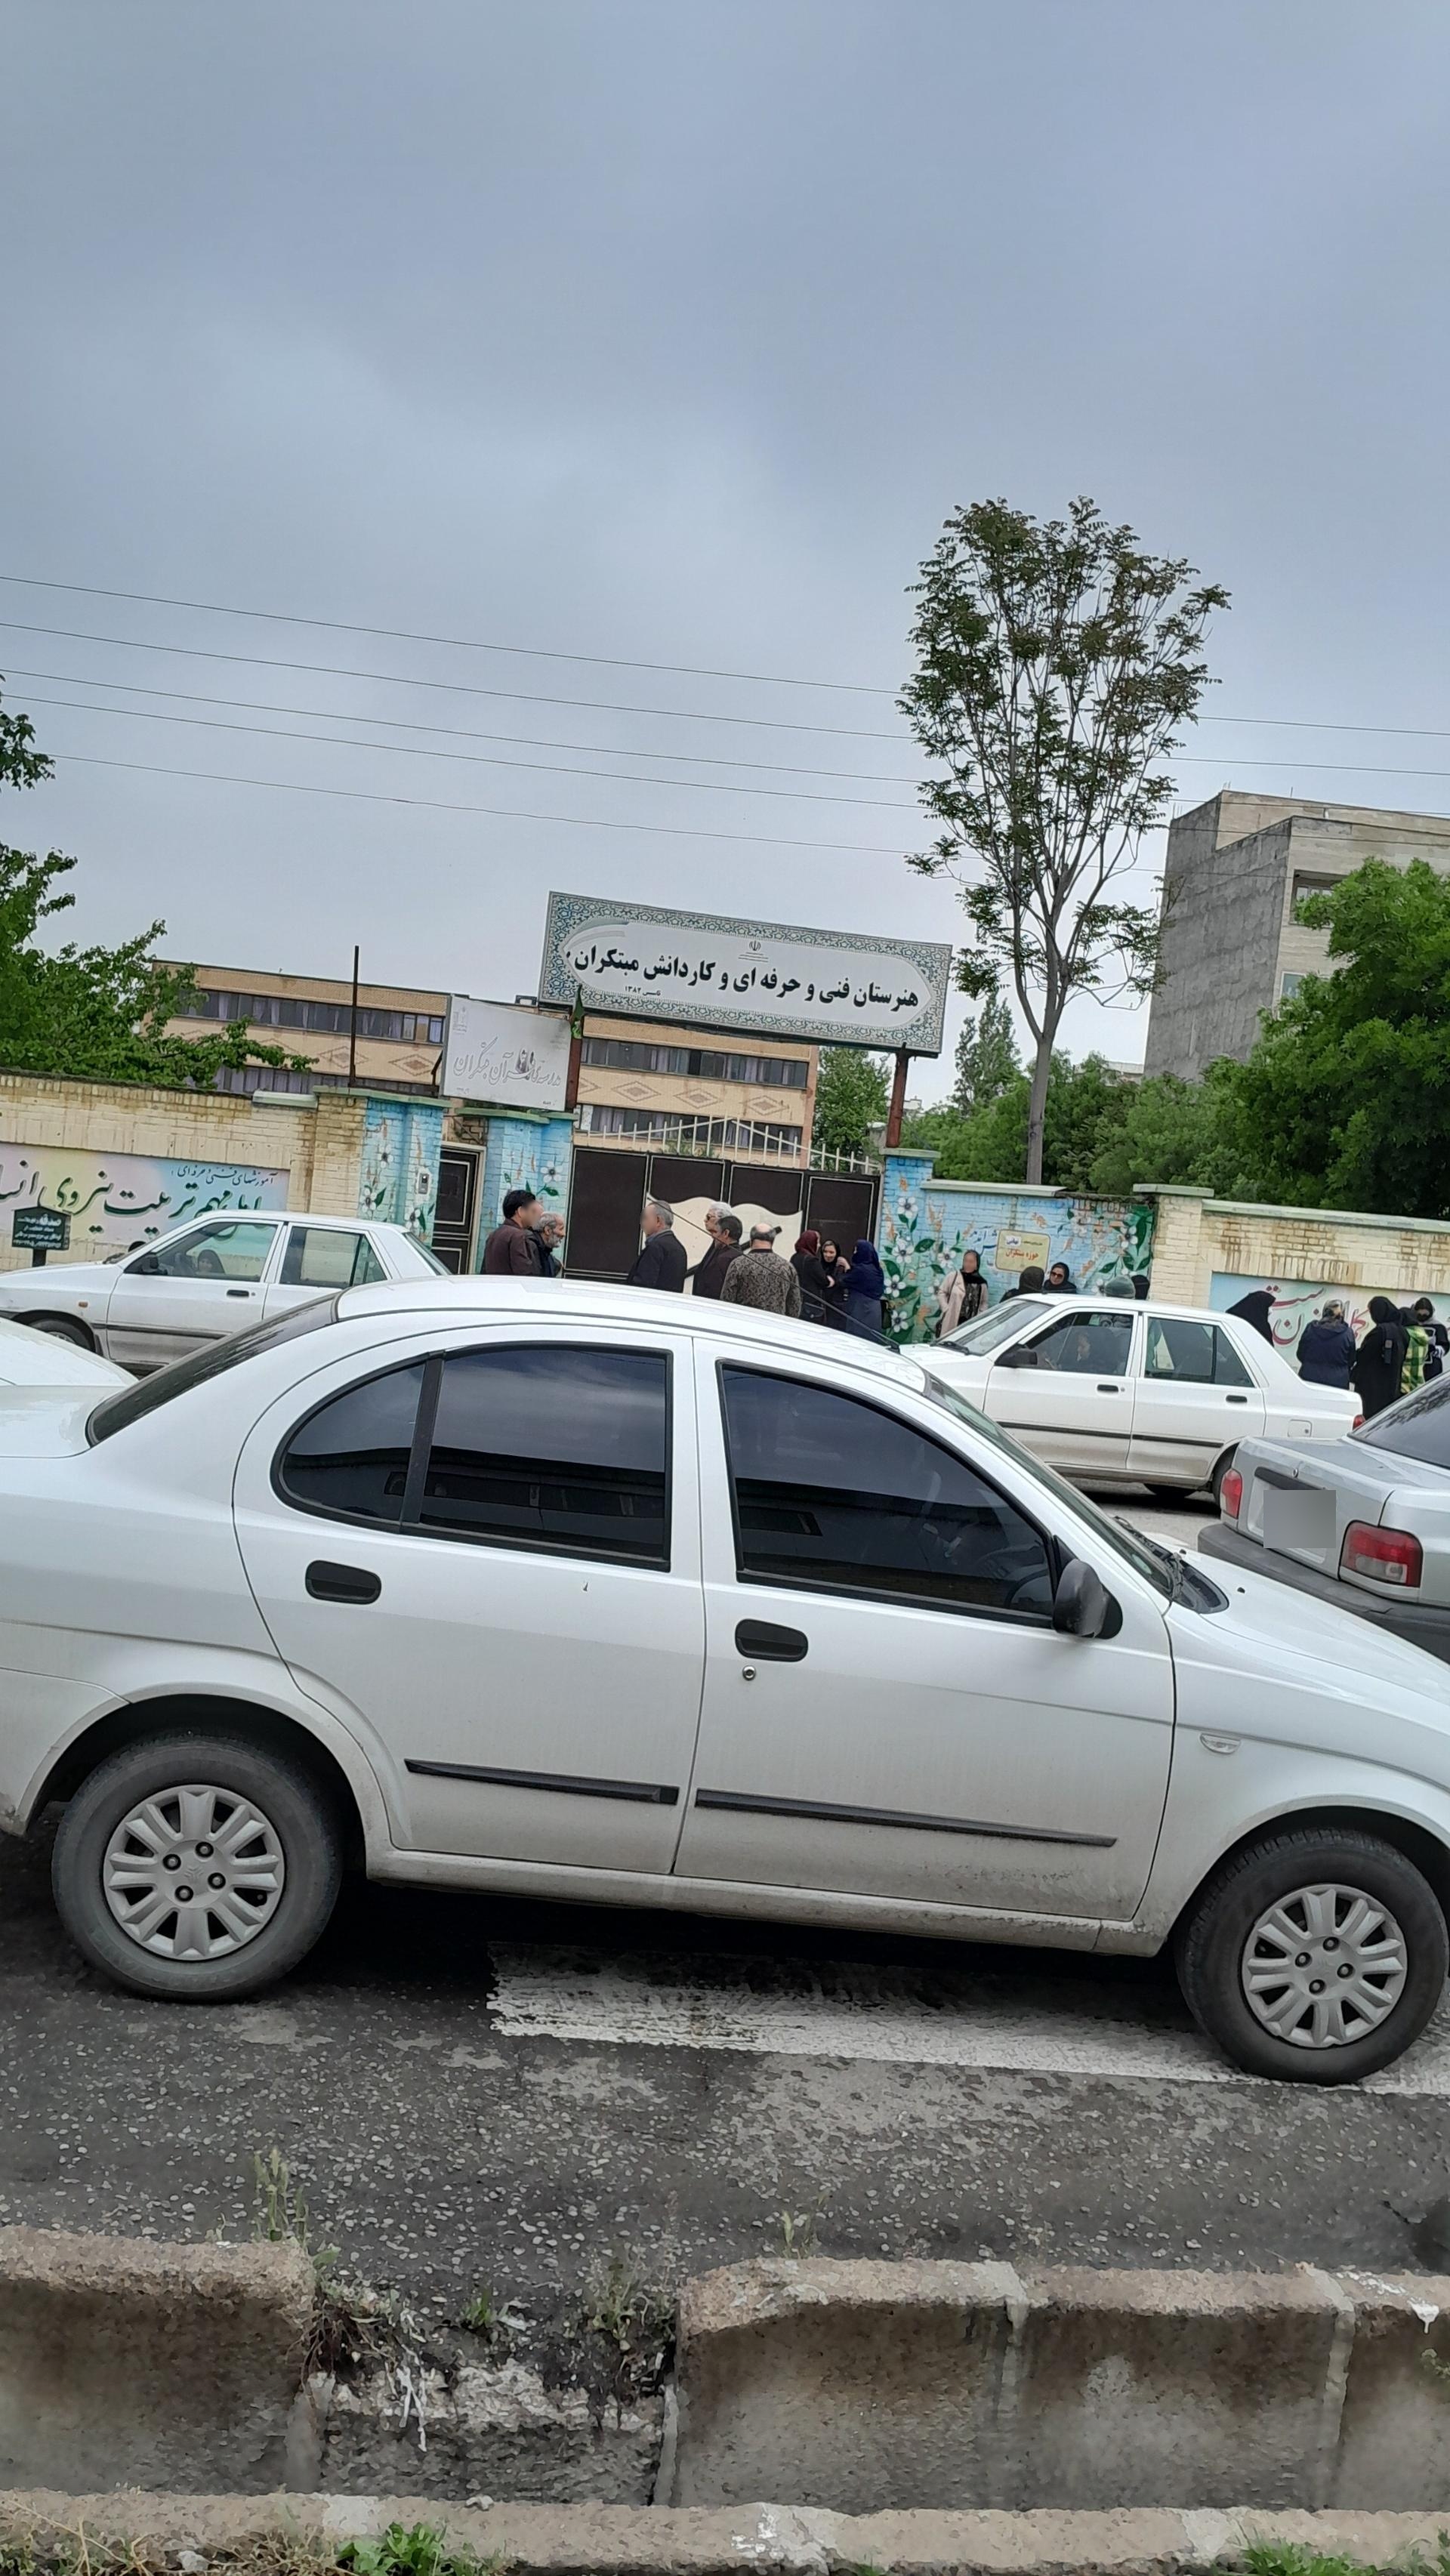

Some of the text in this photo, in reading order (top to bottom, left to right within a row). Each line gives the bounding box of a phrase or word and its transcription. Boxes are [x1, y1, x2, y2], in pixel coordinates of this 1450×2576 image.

[573, 945, 919, 1013] هنرستان فنی و حرفه ای و کاردانش مبتکران
